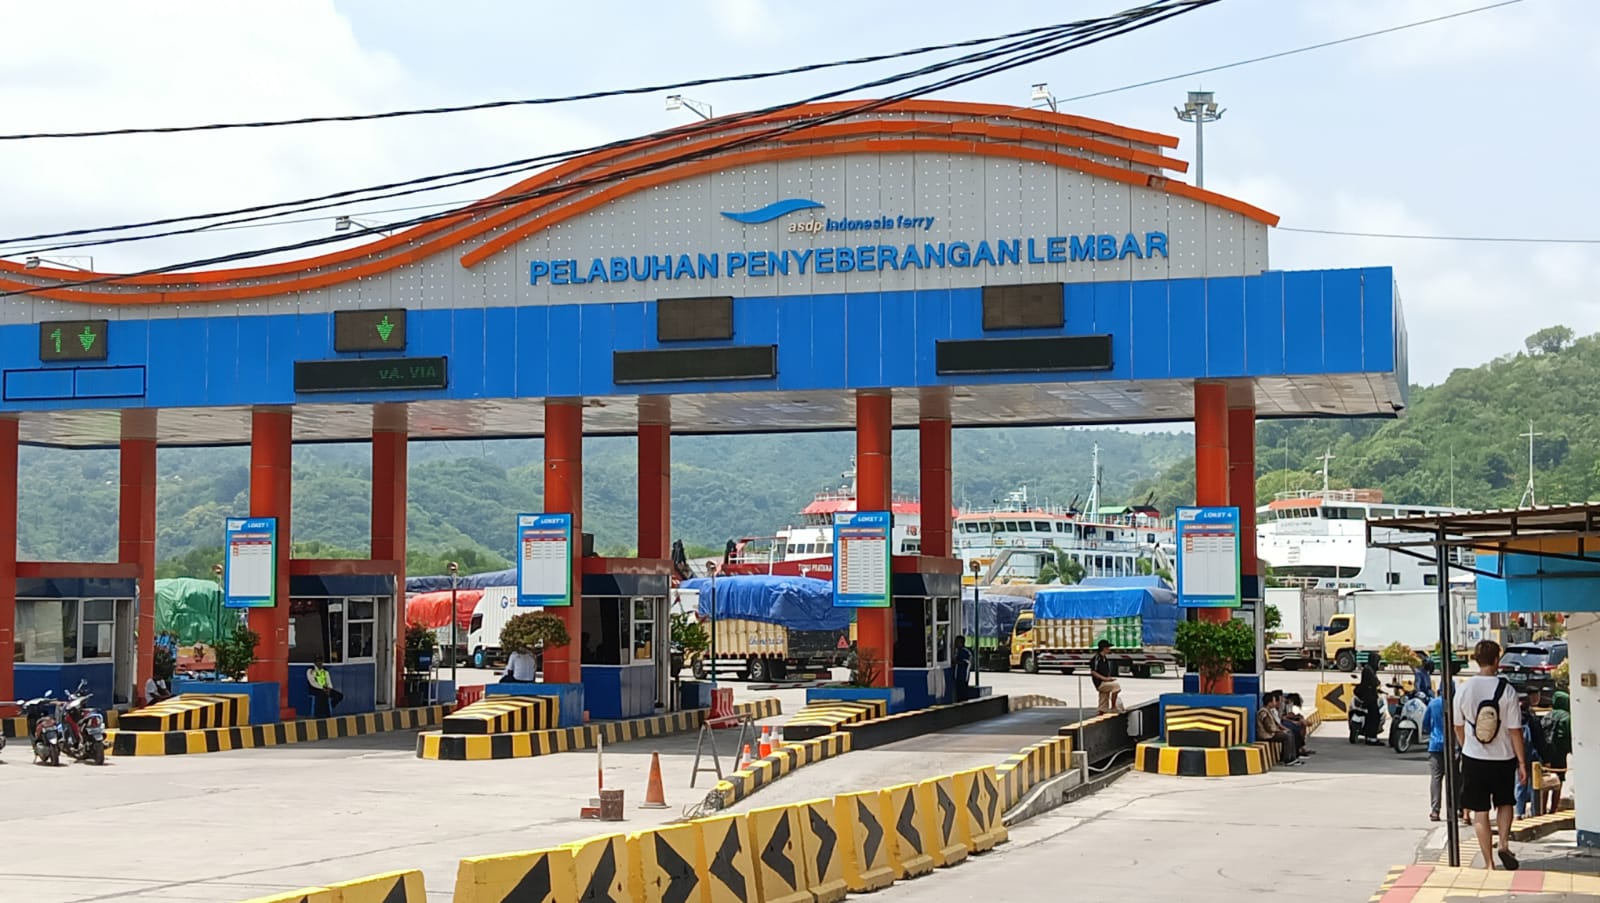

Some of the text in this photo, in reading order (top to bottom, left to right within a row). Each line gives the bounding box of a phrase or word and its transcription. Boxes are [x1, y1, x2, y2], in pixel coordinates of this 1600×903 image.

[788, 217, 823, 235] asdp
[896, 212, 935, 230] ferry
[530, 231, 1169, 286] PELABUHAN PENYEBERANGAN LEMBAR
[50, 328, 62, 353] 1
[409, 365, 437, 379] VIA
